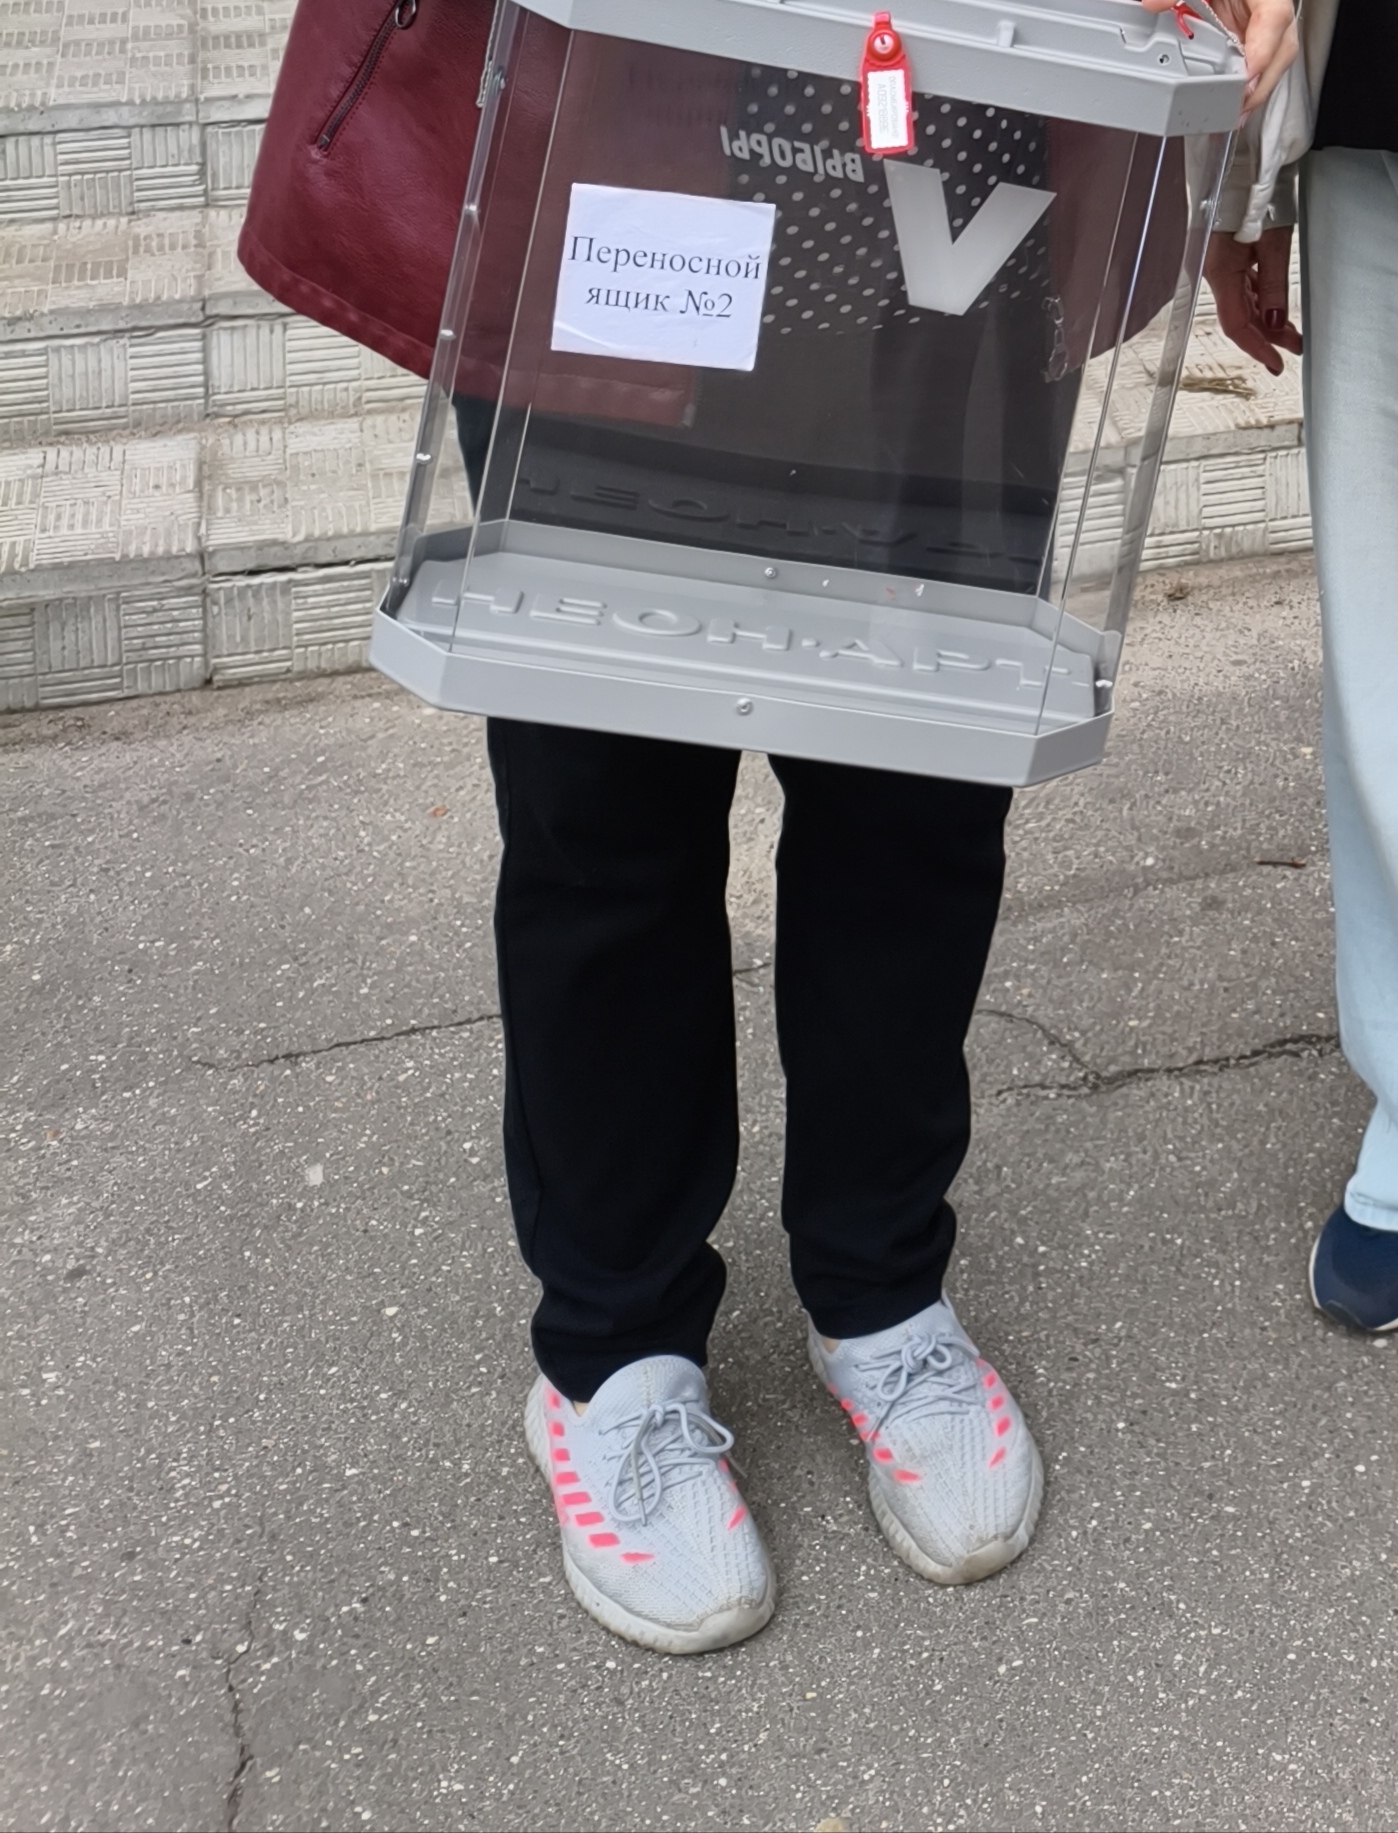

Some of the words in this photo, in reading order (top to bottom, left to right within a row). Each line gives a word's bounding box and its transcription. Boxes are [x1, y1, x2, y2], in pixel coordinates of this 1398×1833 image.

[568, 235, 762, 280] Переносной
[585, 287, 671, 313] ящик
[679, 289, 733, 318] №2
